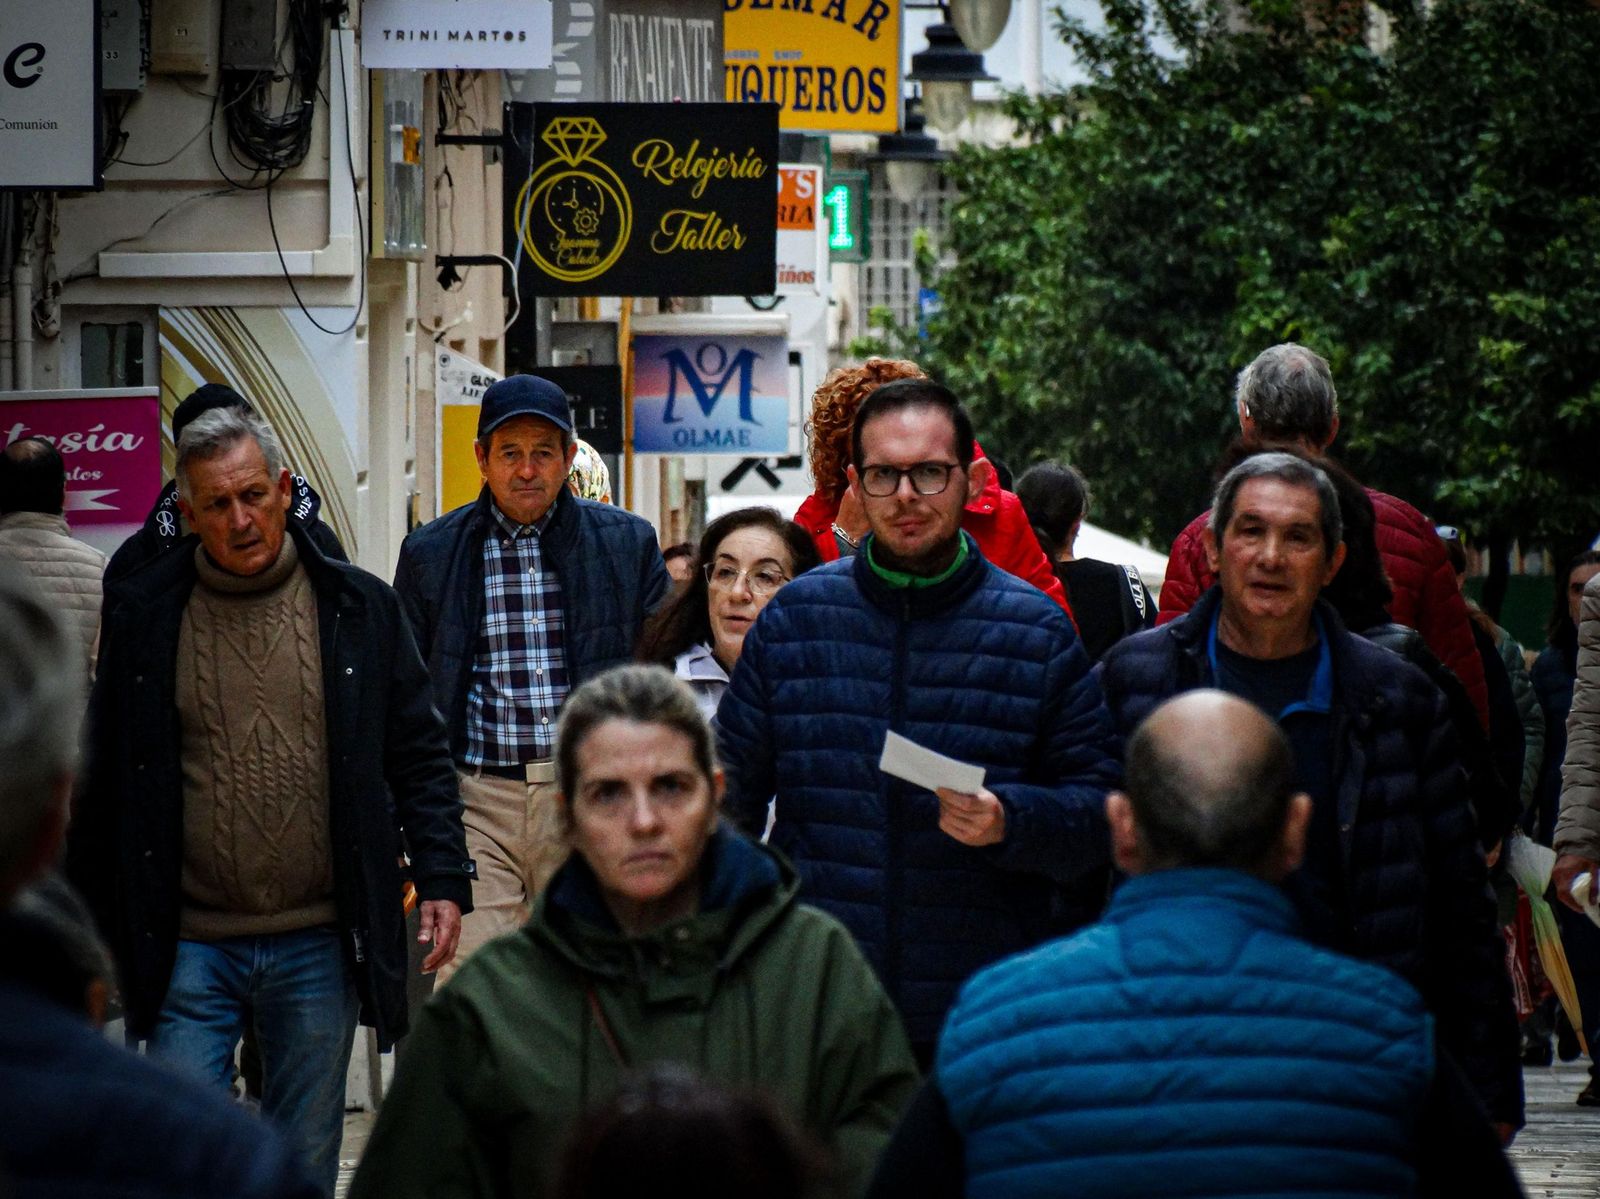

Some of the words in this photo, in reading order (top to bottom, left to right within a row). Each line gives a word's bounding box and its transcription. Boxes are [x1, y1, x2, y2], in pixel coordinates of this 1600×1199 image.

[383, 29, 438, 41] TRINI
[448, 30, 527, 42] MARTOS
[105, 51, 119, 59] 33
[632, 138, 768, 200] Relojería
[650, 209, 747, 254] Taller
[673, 428, 751, 447] OLMAE
